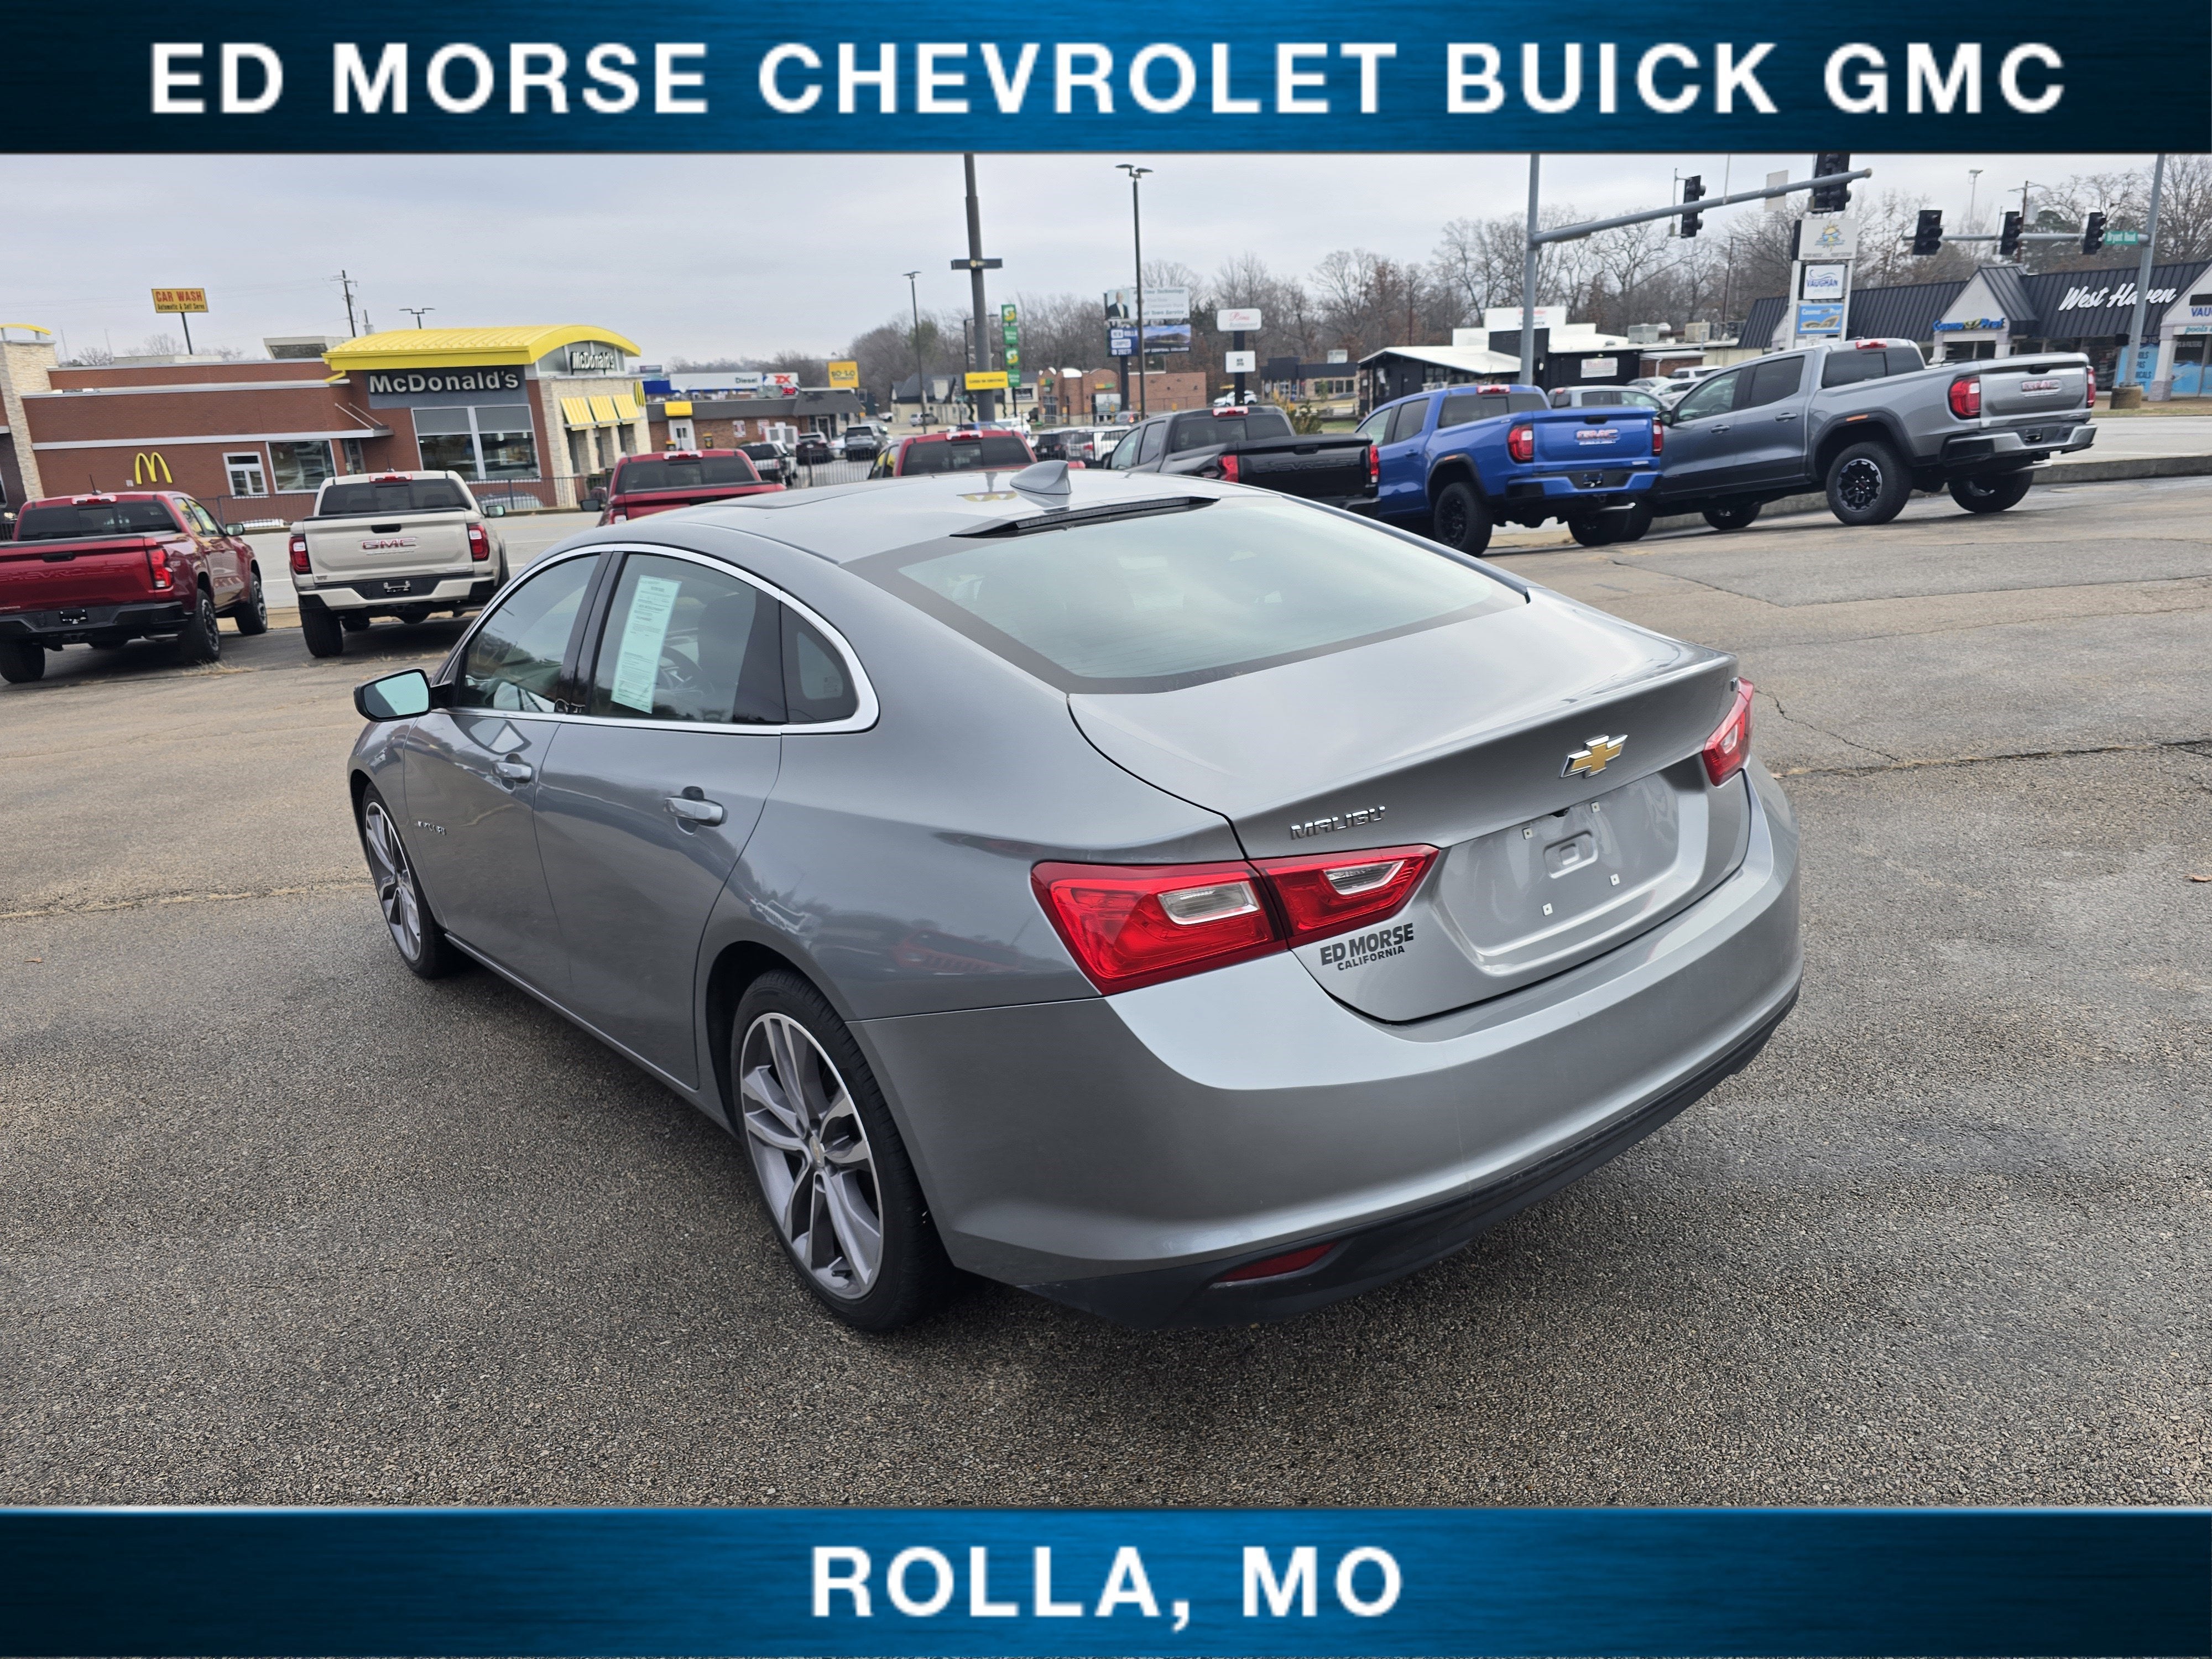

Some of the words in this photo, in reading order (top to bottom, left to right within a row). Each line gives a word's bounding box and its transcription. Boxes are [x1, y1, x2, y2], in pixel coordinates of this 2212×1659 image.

[155, 291, 174, 302] CAR
[176, 291, 202, 302] WASH
[2058, 285, 2109, 311] West
[2106, 283, 2177, 308] Haen
[2191, 307, 2212, 317] VAU
[572, 351, 615, 369] McDonald's
[369, 371, 519, 393] McDonald's
[362, 538, 416, 549] GMC
[1290, 806, 1386, 840] MALIBU
[1319, 942, 1346, 966] ED
[1349, 922, 1414, 958] MORSE
[1337, 945, 1405, 971] CALIFORNIA
